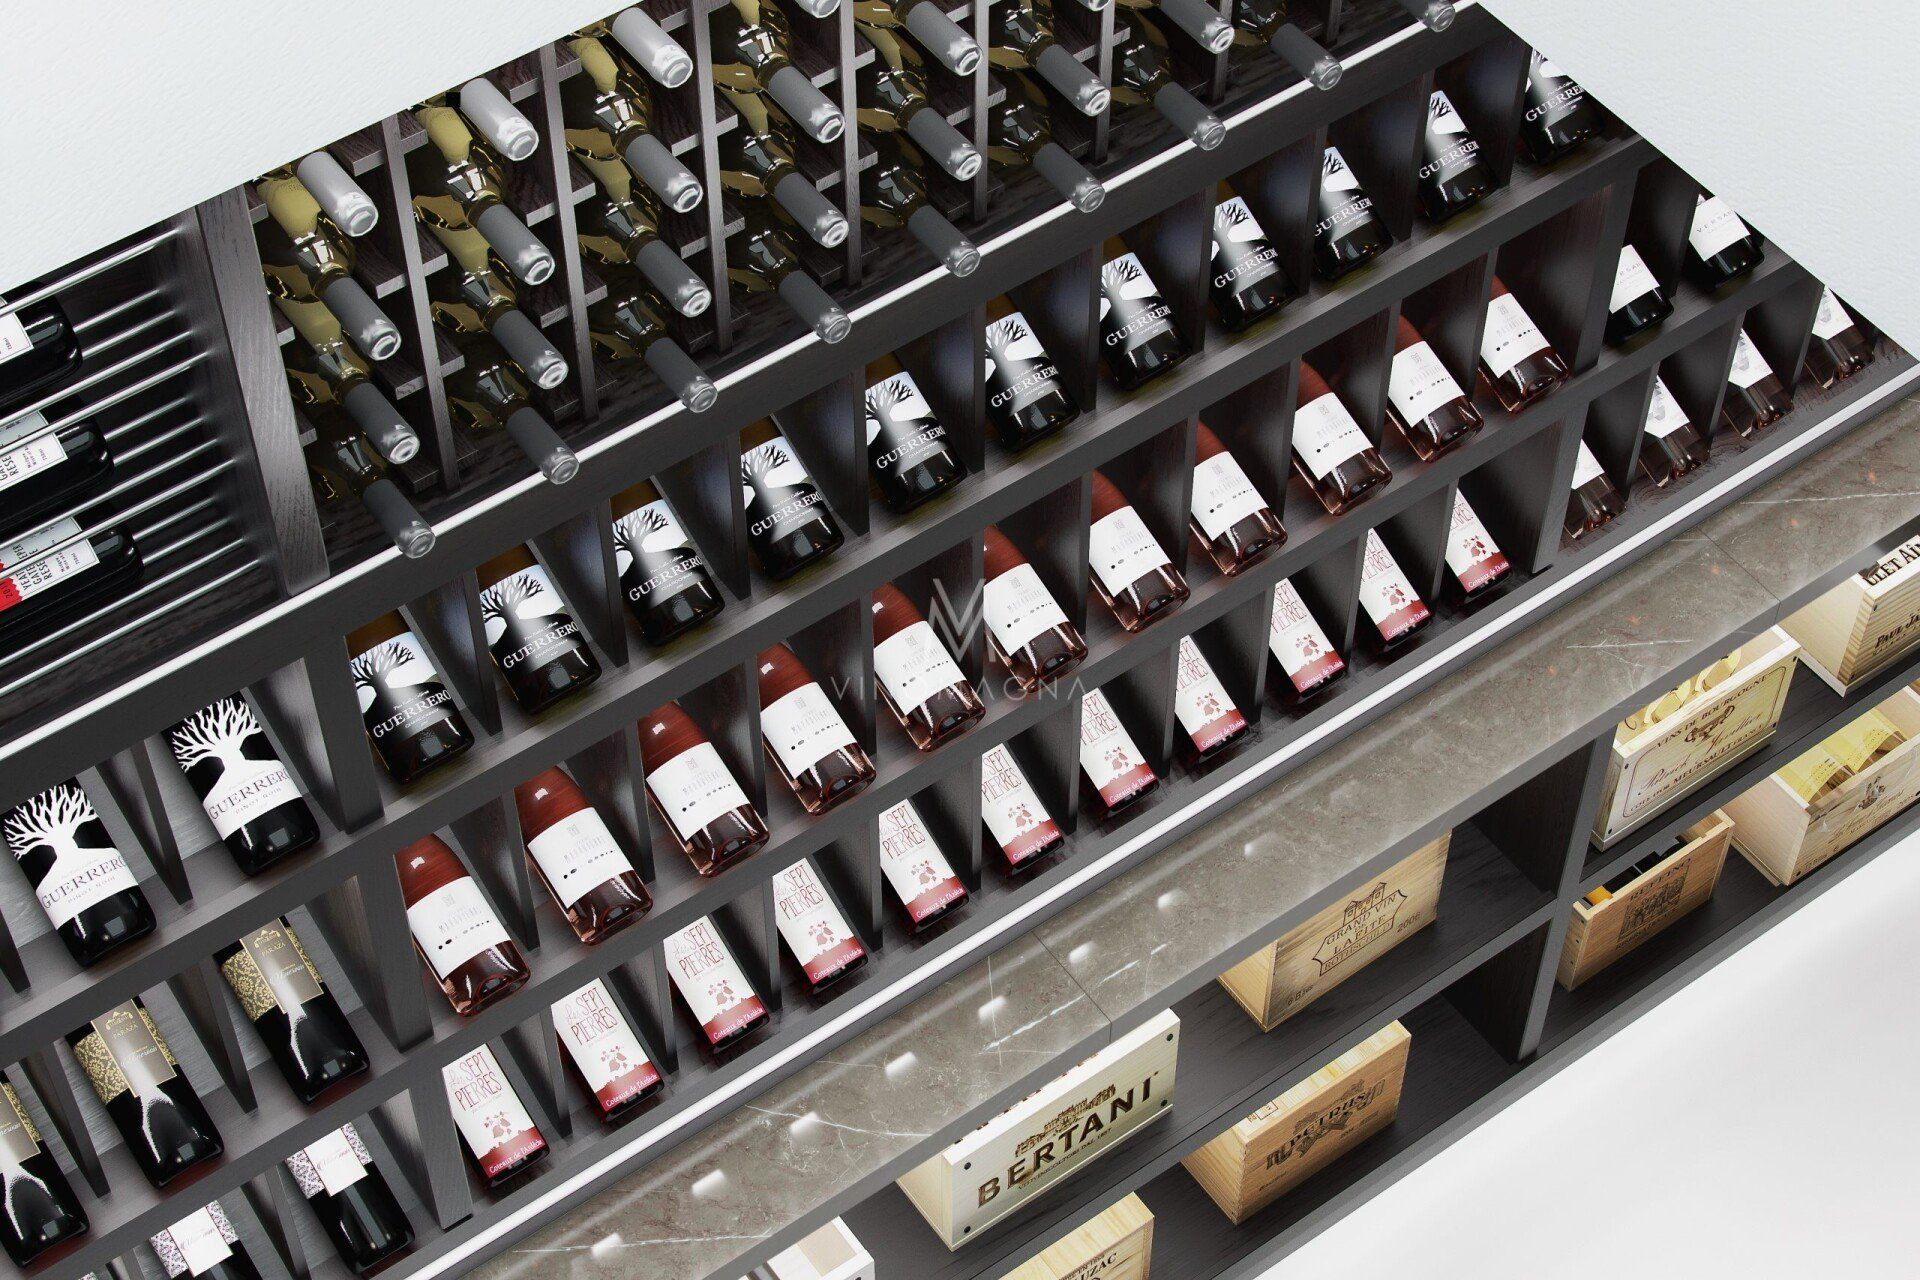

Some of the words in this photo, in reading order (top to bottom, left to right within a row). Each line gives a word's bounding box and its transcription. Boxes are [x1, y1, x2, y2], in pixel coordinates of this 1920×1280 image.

[1214, 247, 1279, 288] GUERRER
[1106, 305, 1172, 346] GUERRER
[991, 365, 1059, 407] GUERRER
[629, 555, 703, 601] GUERRERO
[1361, 549, 1394, 582] IERRES
[503, 621, 579, 669] GUERRERO
[1179, 640, 1198, 665] EPT
[1175, 657, 1209, 692] IERRES
[373, 689, 452, 738] GUERRERO
[1655, 727, 1682, 749] VINS
[1684, 717, 1698, 731] DE
[1700, 673, 1767, 721] BOURGOGNE
[983, 749, 1011, 775] SEPT
[981, 767, 1022, 803] PIERRES
[886, 805, 914, 832] SEPT
[882, 823, 926, 860] PIERRES
[783, 864, 812, 892] SEPT
[779, 882, 824, 921] PIERRES
[1325, 909, 1371, 946] GRAND
[1374, 892, 1396, 914] VIN
[683, 922, 713, 950] SEPT
[1323, 921, 1390, 971] ROTHSCHILD
[1333, 913, 1386, 955] LAFITE
[678, 941, 725, 980] PIERRES
[813, 965, 837, 980] Coteaux
[575, 987, 606, 1016] SEPT
[570, 1006, 618, 1046] PIERRES
[713, 1024, 736, 1040] Coteaux
[460, 1052, 491, 1081] SEPT
[454, 1071, 502, 1112] PIERRES
[605, 1091, 630, 1107] Coteaux
[977, 1076, 1151, 1208] BERTANI
